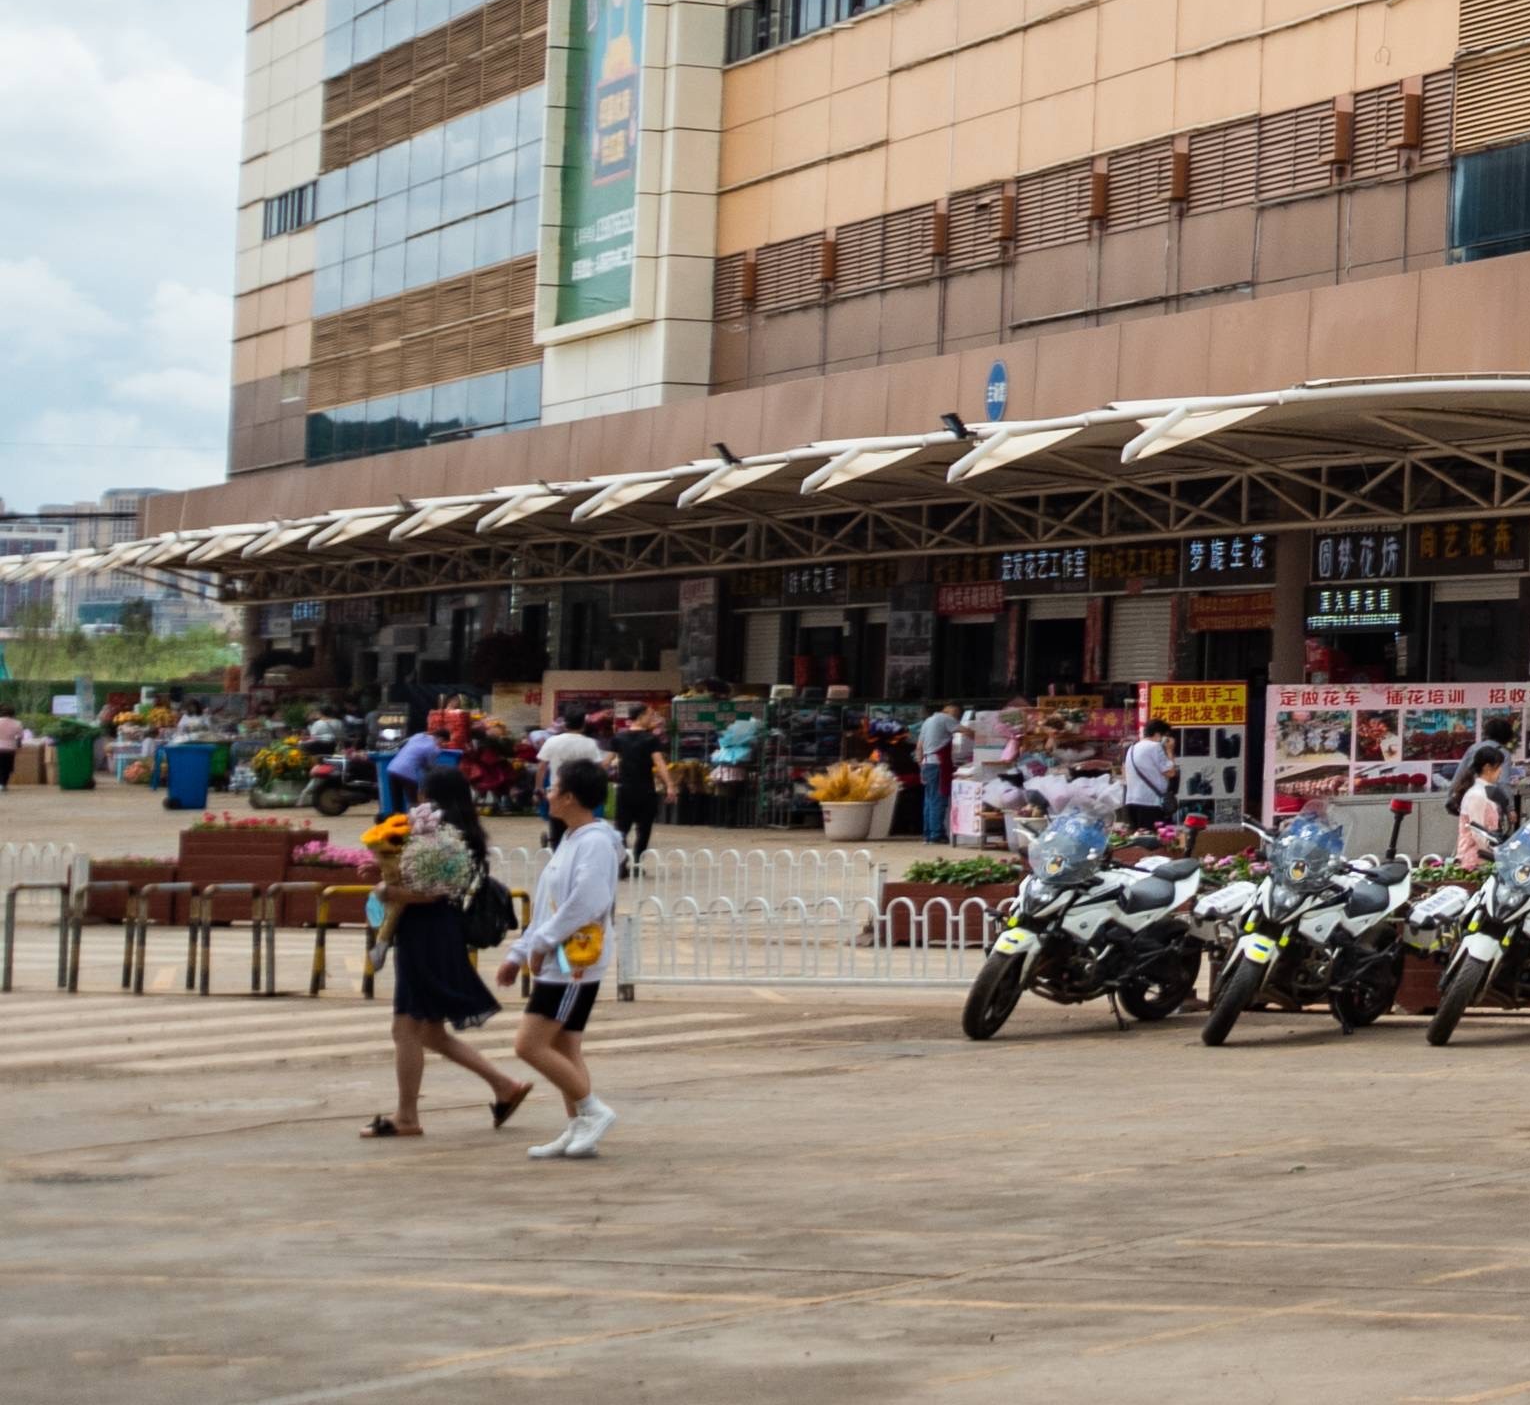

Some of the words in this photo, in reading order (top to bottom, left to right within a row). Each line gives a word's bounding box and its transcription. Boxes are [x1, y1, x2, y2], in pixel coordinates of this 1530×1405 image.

[1161, 686, 1238, 704] 景德镇手工
[1280, 690, 1361, 707] 定做花车
[1386, 689, 1465, 705] 插花培训
